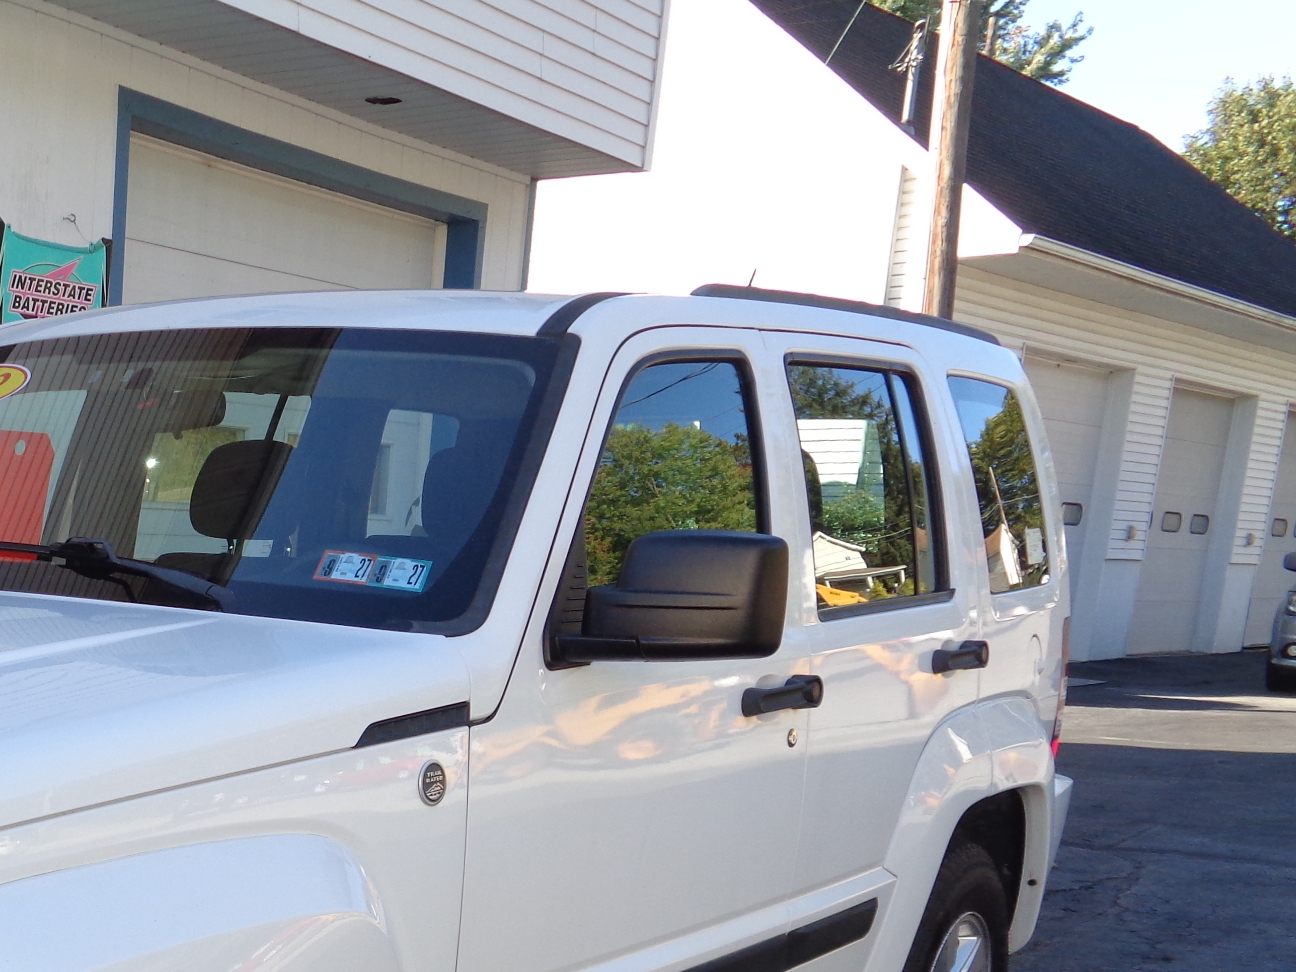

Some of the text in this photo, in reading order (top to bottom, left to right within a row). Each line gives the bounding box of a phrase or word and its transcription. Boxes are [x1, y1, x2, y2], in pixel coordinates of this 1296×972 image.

[10, 273, 94, 303] INTERSTATE
[354, 558, 372, 580] 27
[406, 563, 426, 587] 27
